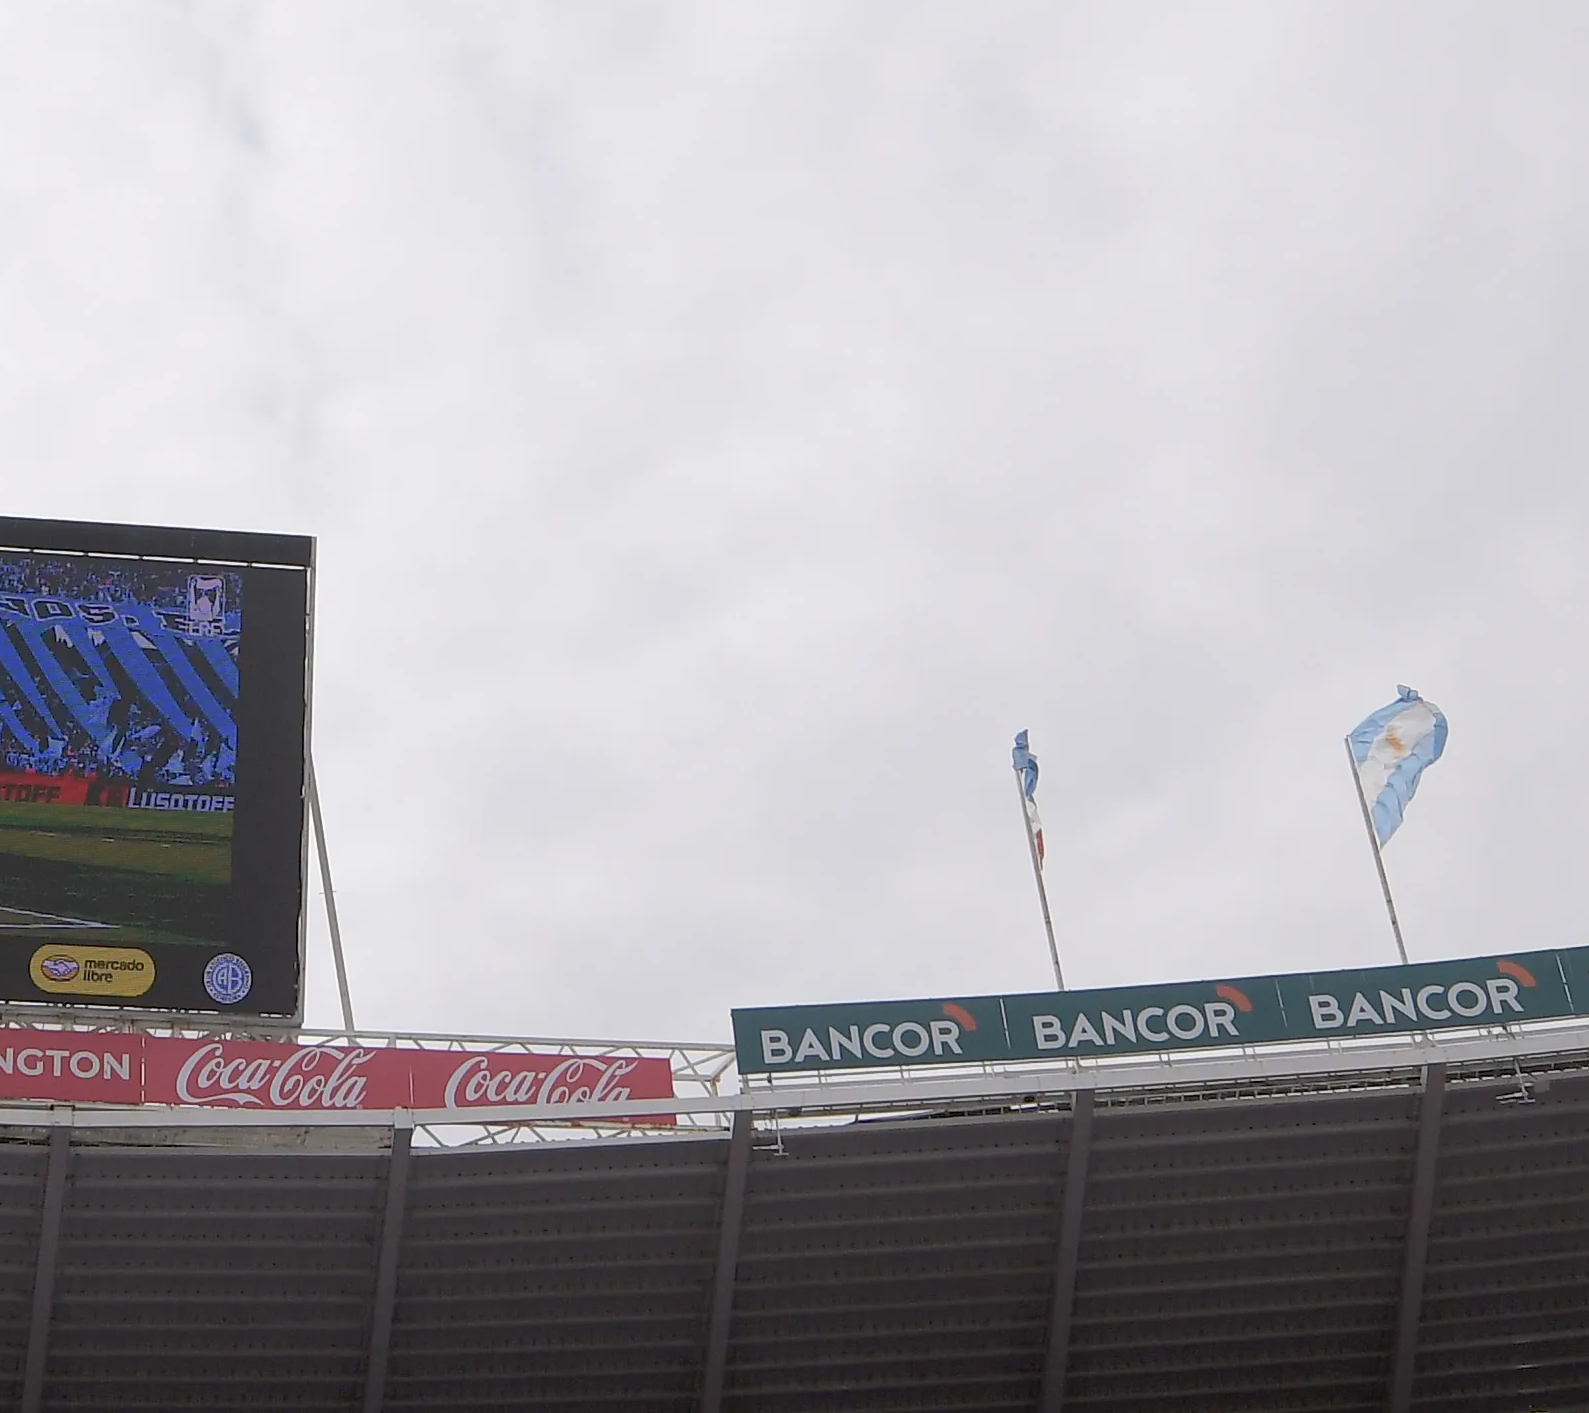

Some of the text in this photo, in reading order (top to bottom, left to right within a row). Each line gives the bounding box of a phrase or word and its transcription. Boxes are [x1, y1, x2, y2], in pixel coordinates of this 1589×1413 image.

[82, 969, 114, 984] libre
[83, 959, 145, 973] mercado
[1032, 1000, 1240, 1051] BANCOR
[1309, 977, 1524, 1030] BANCOR
[759, 1019, 963, 1065] BANCOR
[176, 1042, 377, 1110] Coca-Cola
[446, 1056, 638, 1108] Coca-Cola
